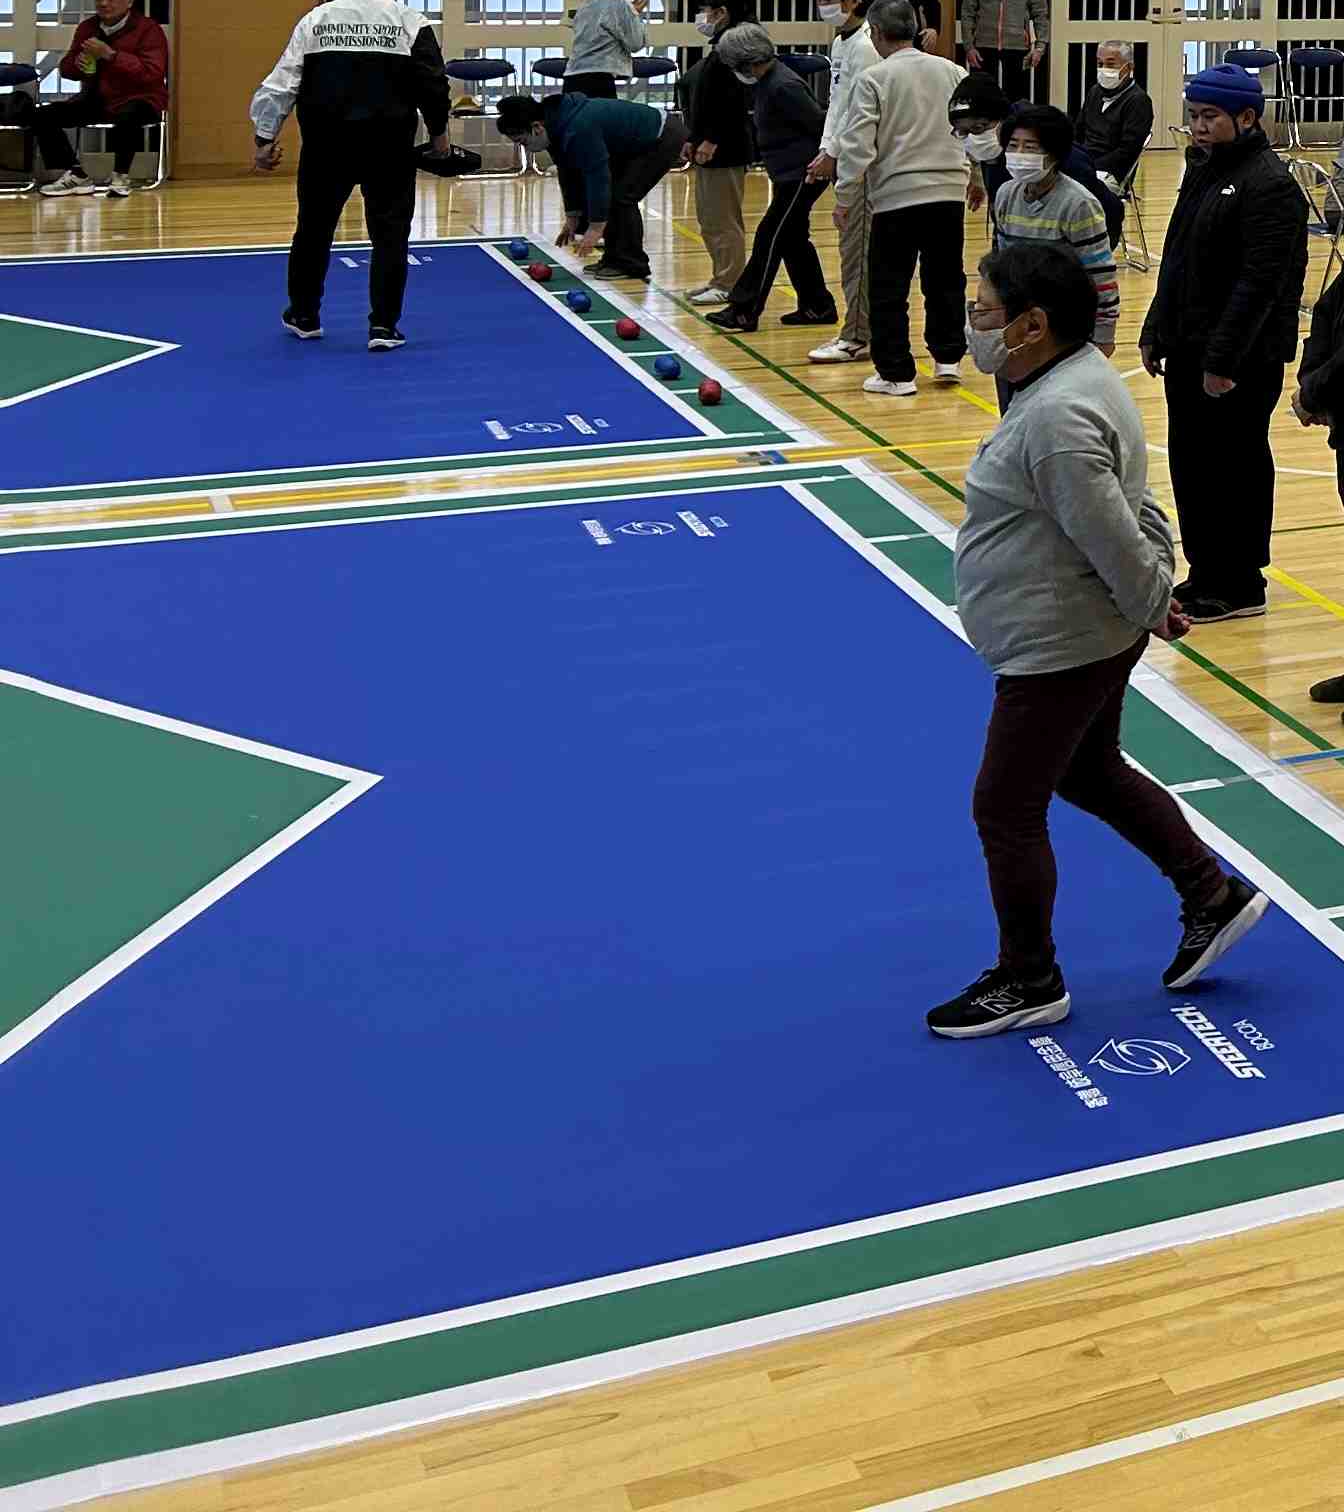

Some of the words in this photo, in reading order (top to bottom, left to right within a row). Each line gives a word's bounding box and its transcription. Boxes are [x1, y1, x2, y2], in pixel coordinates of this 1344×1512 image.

[312, 23, 369, 37] COMMUNITY
[372, 23, 402, 37] SPORT
[319, 35, 397, 49] COMMISSIONERS
